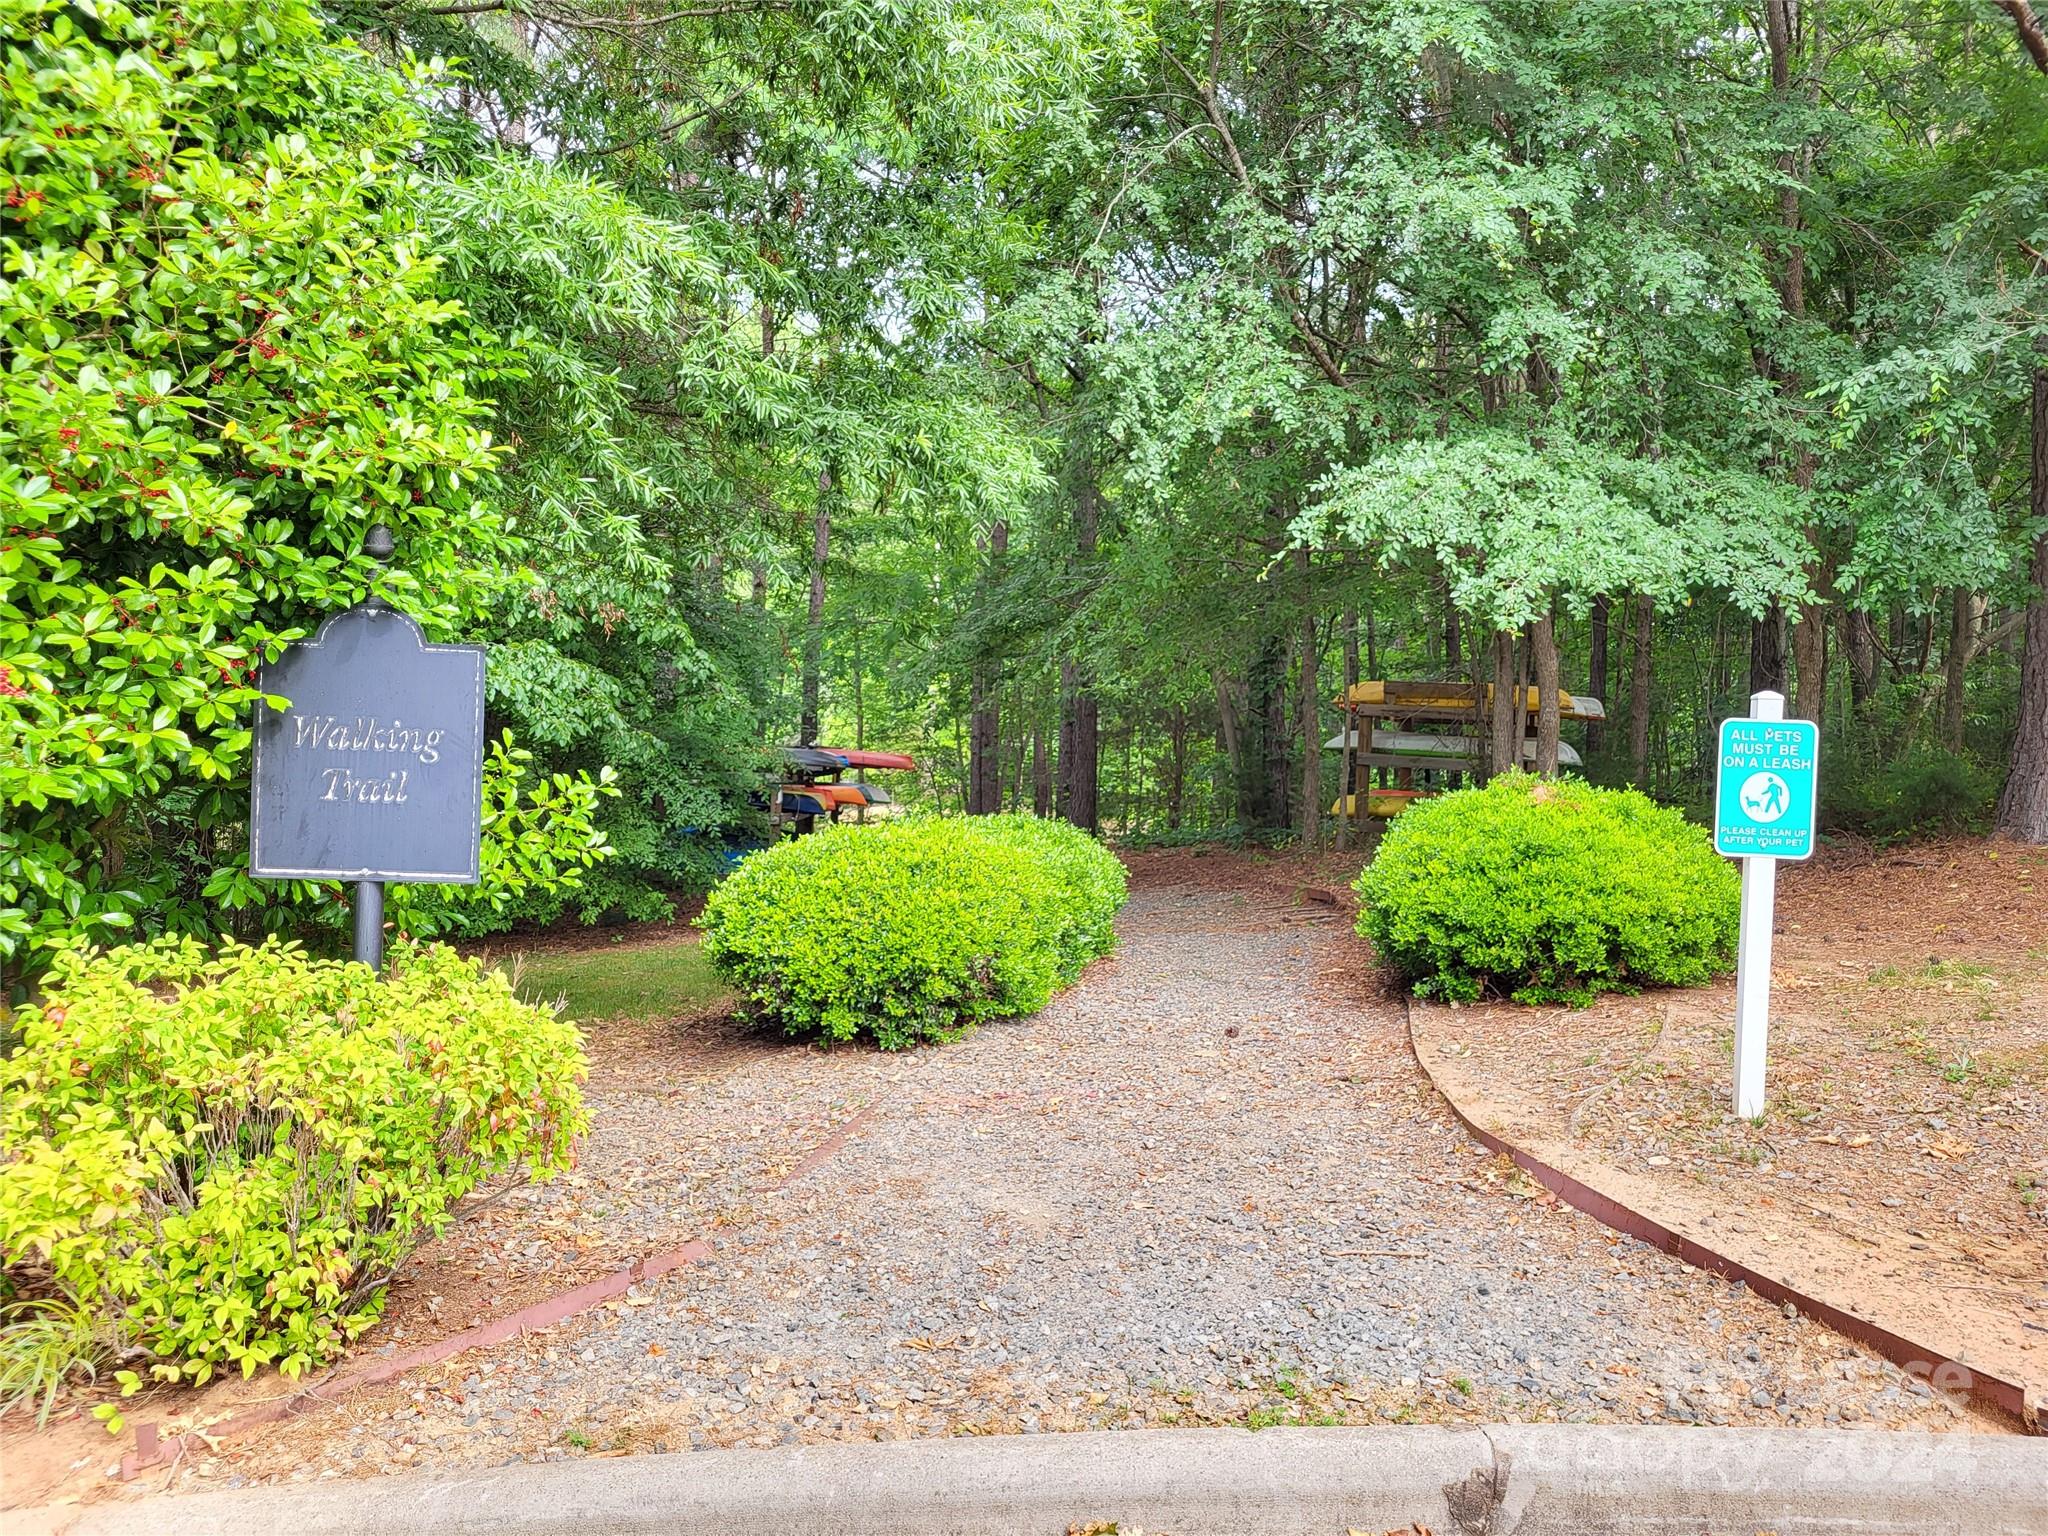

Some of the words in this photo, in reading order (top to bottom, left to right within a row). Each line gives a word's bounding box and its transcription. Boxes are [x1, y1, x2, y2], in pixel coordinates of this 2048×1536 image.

[292, 714, 445, 764] Walking
[1730, 729, 1758, 741] ALL
[1765, 729, 1802, 742] PETS
[1732, 743, 1773, 755] MUST
[1779, 744, 1799, 756] BE
[1723, 755, 1745, 768] ON
[1748, 756, 1759, 768] A
[1763, 757, 1811, 770] LEASH
[319, 767, 409, 805] Trail
[1720, 826, 1757, 835] PLEASE
[1759, 827, 1792, 837] CLEAN
[1794, 829, 1808, 838] UP
[1723, 836, 1754, 845] AFTER
[1757, 837, 1782, 846] YOUR
[1786, 838, 1804, 847] PET
